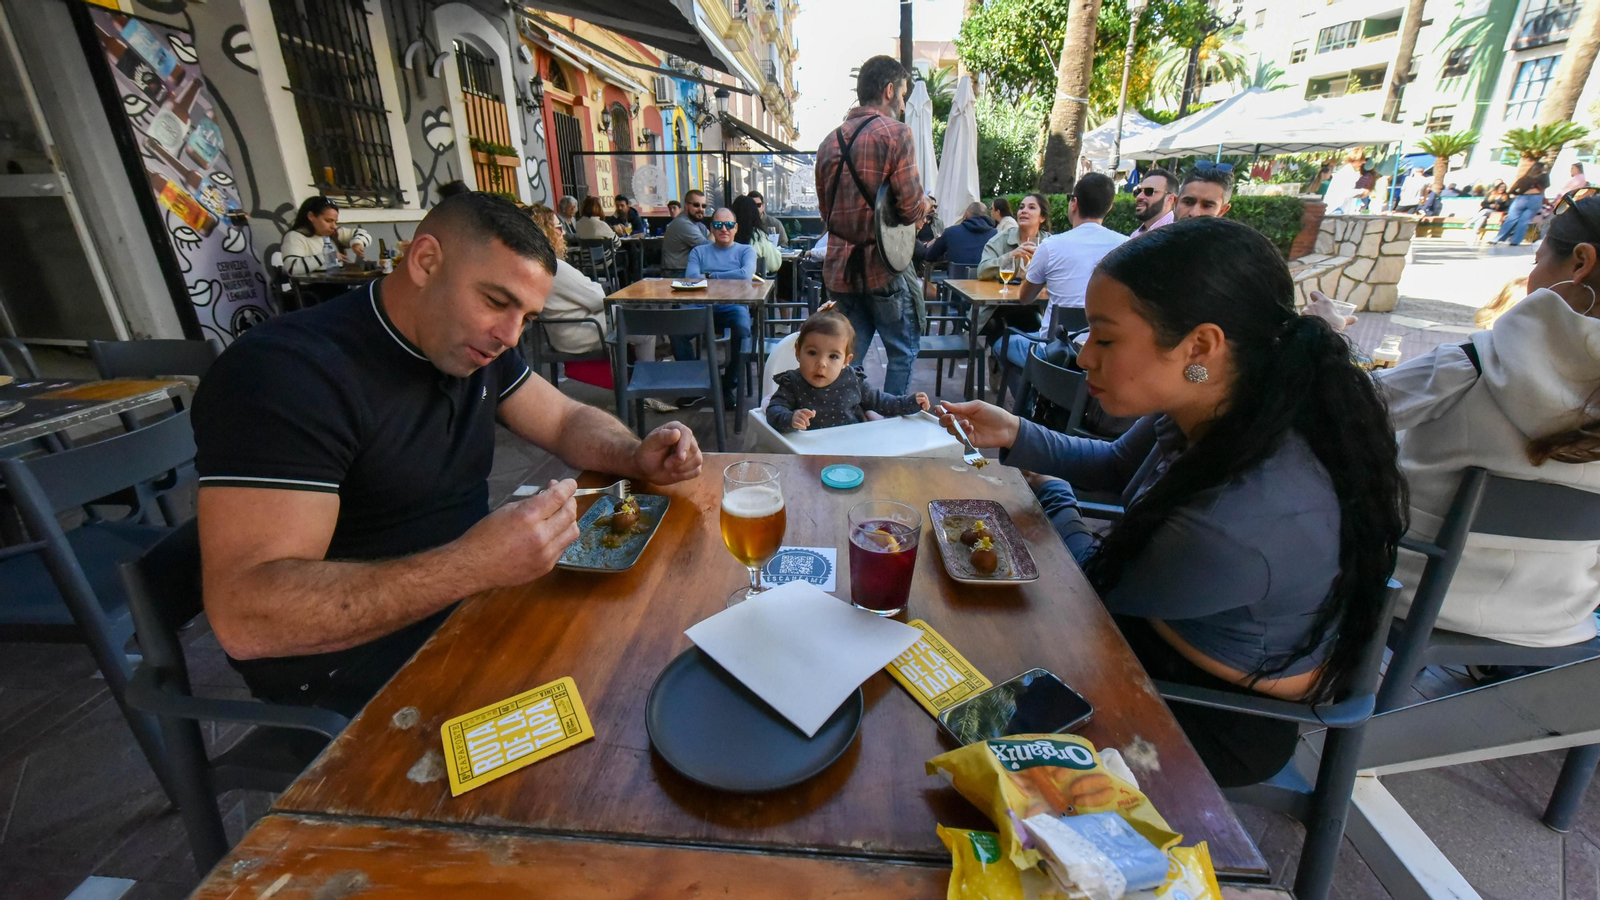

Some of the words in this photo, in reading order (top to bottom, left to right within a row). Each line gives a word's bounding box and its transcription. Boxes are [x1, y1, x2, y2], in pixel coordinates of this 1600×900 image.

[596, 158, 610, 173] PATIO
[602, 177, 609, 191] DE
[217, 260, 248, 272] CERVEZAS
[223, 279, 255, 291] NUESTRO
[226, 289, 258, 302] LENGUAJE
[900, 660, 928, 682] DE
[920, 651, 947, 670] LA
[915, 665, 965, 698] TAPA
[497, 709, 527, 736] LA
[525, 698, 563, 749] TAPA
[452, 725, 468, 773] TAPAPORTE
[466, 720, 505, 775] RUTA
[503, 732, 535, 761] DE
[989, 740, 1094, 769] Organix
